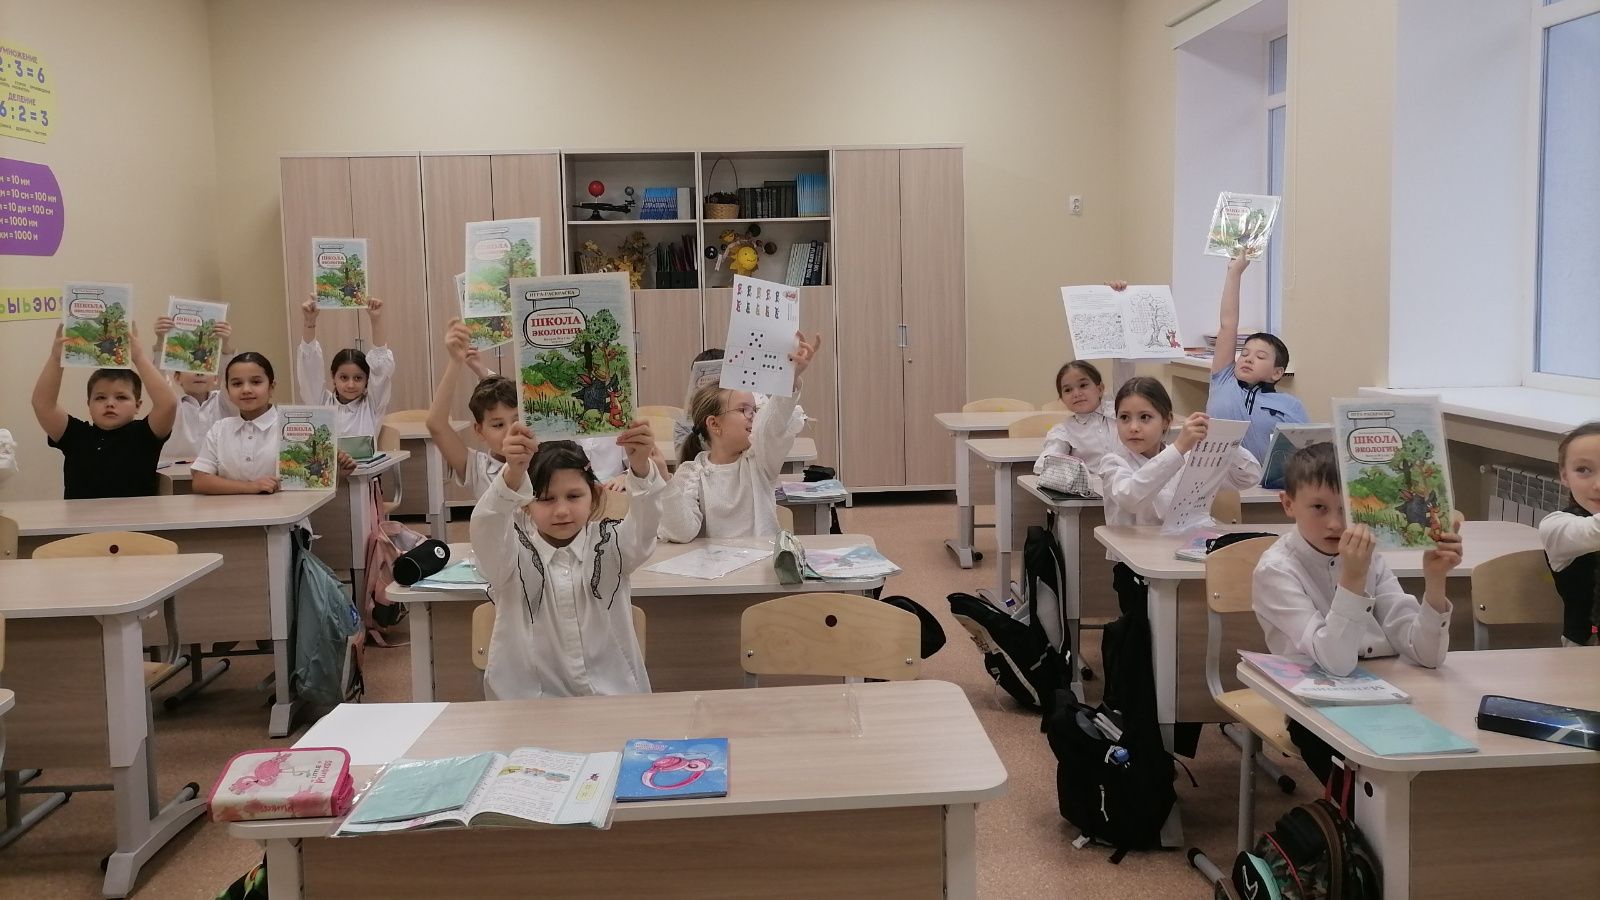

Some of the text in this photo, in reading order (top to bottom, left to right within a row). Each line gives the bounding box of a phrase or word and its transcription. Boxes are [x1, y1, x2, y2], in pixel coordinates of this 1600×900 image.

[15, 60, 23, 77] 3
[37, 67, 45, 83] 6
[8, 92, 36, 106] ДЕЛЕНИЕ
[0, 100, 7, 117] 6
[18, 105, 26, 122] 2
[40, 109, 49, 127] 3
[11, 175, 19, 185] 10
[11, 189, 19, 199] 10
[34, 191, 47, 201] 100
[8, 202, 17, 212] 10
[32, 204, 45, 215] 100
[9, 216, 28, 227] 1000
[14, 230, 33, 241] 1000
[531, 316, 582, 328] ШКОЛА
[1353, 435, 1398, 445] ШКОЛА
